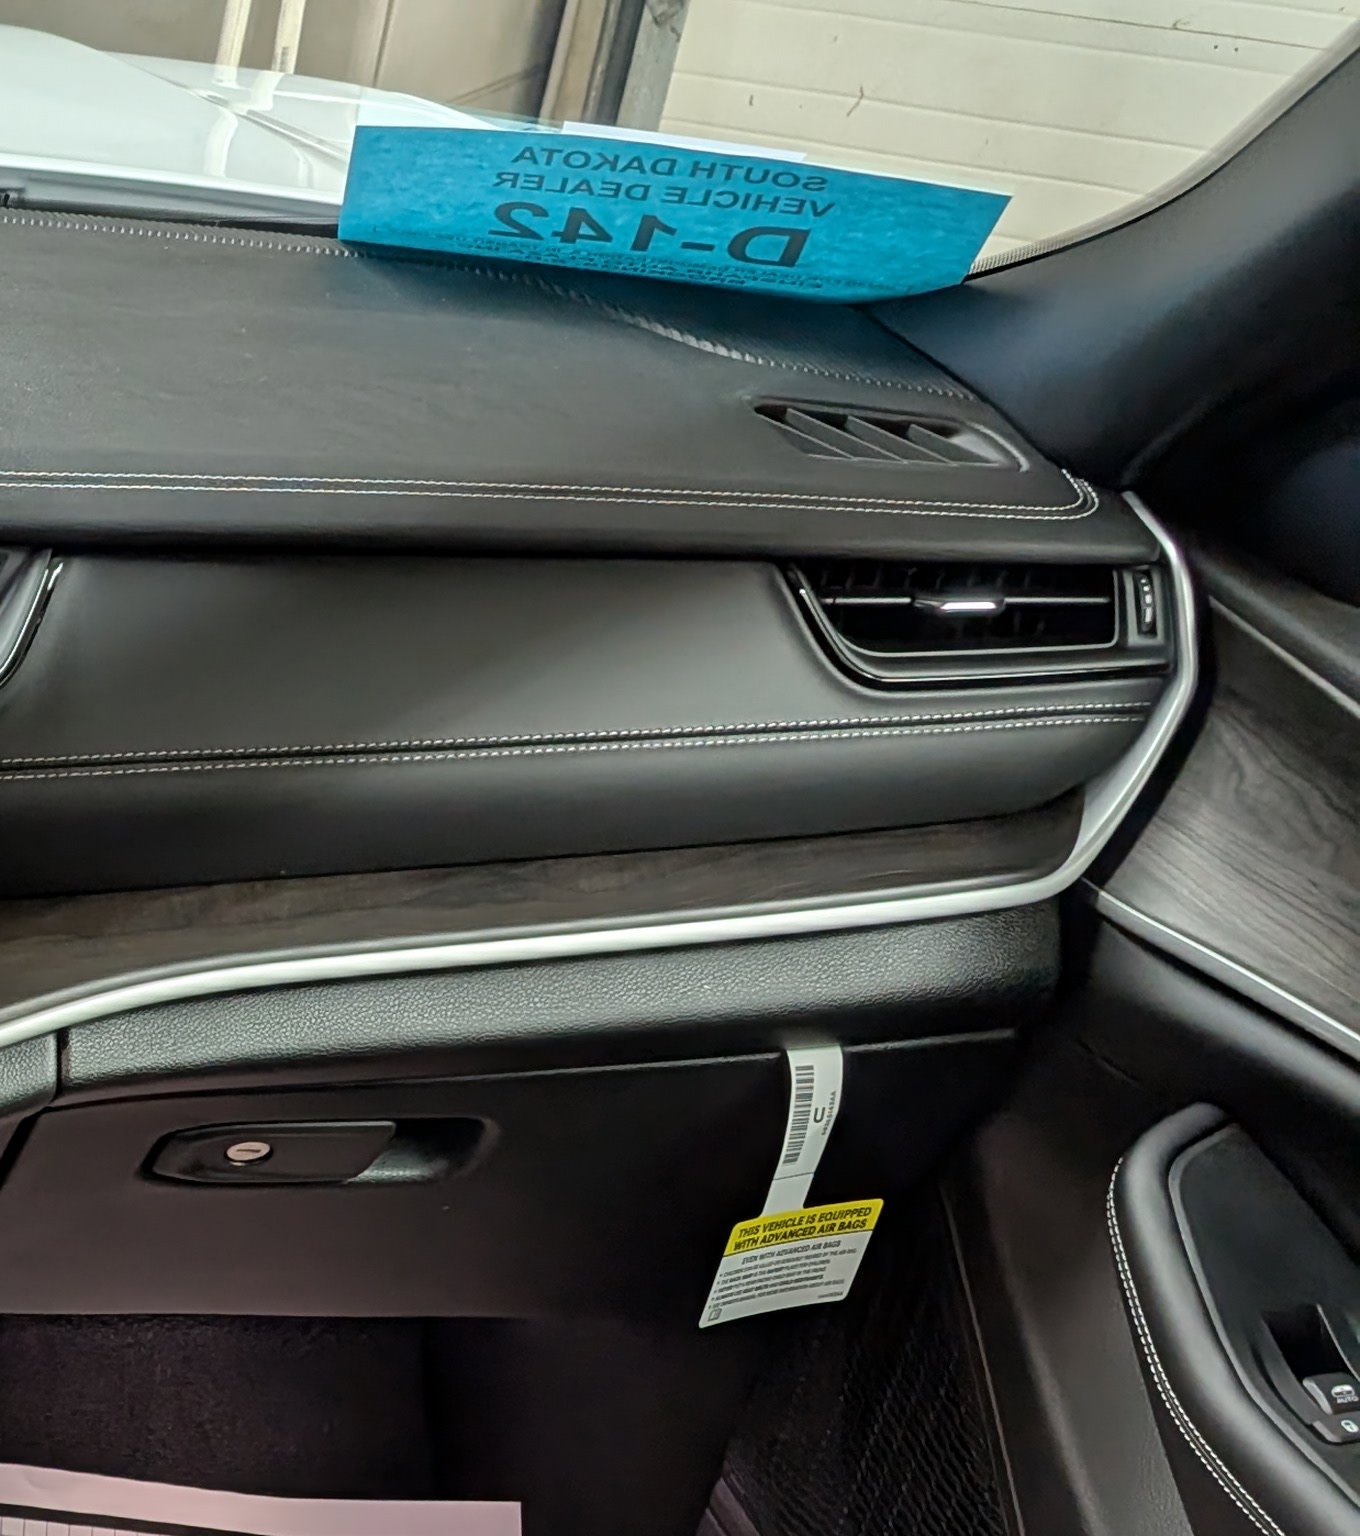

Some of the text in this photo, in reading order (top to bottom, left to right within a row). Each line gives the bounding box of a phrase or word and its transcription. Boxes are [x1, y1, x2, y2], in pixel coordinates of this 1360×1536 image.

[734, 1219, 867, 1251] WITH ADVANCED AIR BAGS
[738, 1207, 872, 1239] THIS VEHICLE IS EQUIPPED
